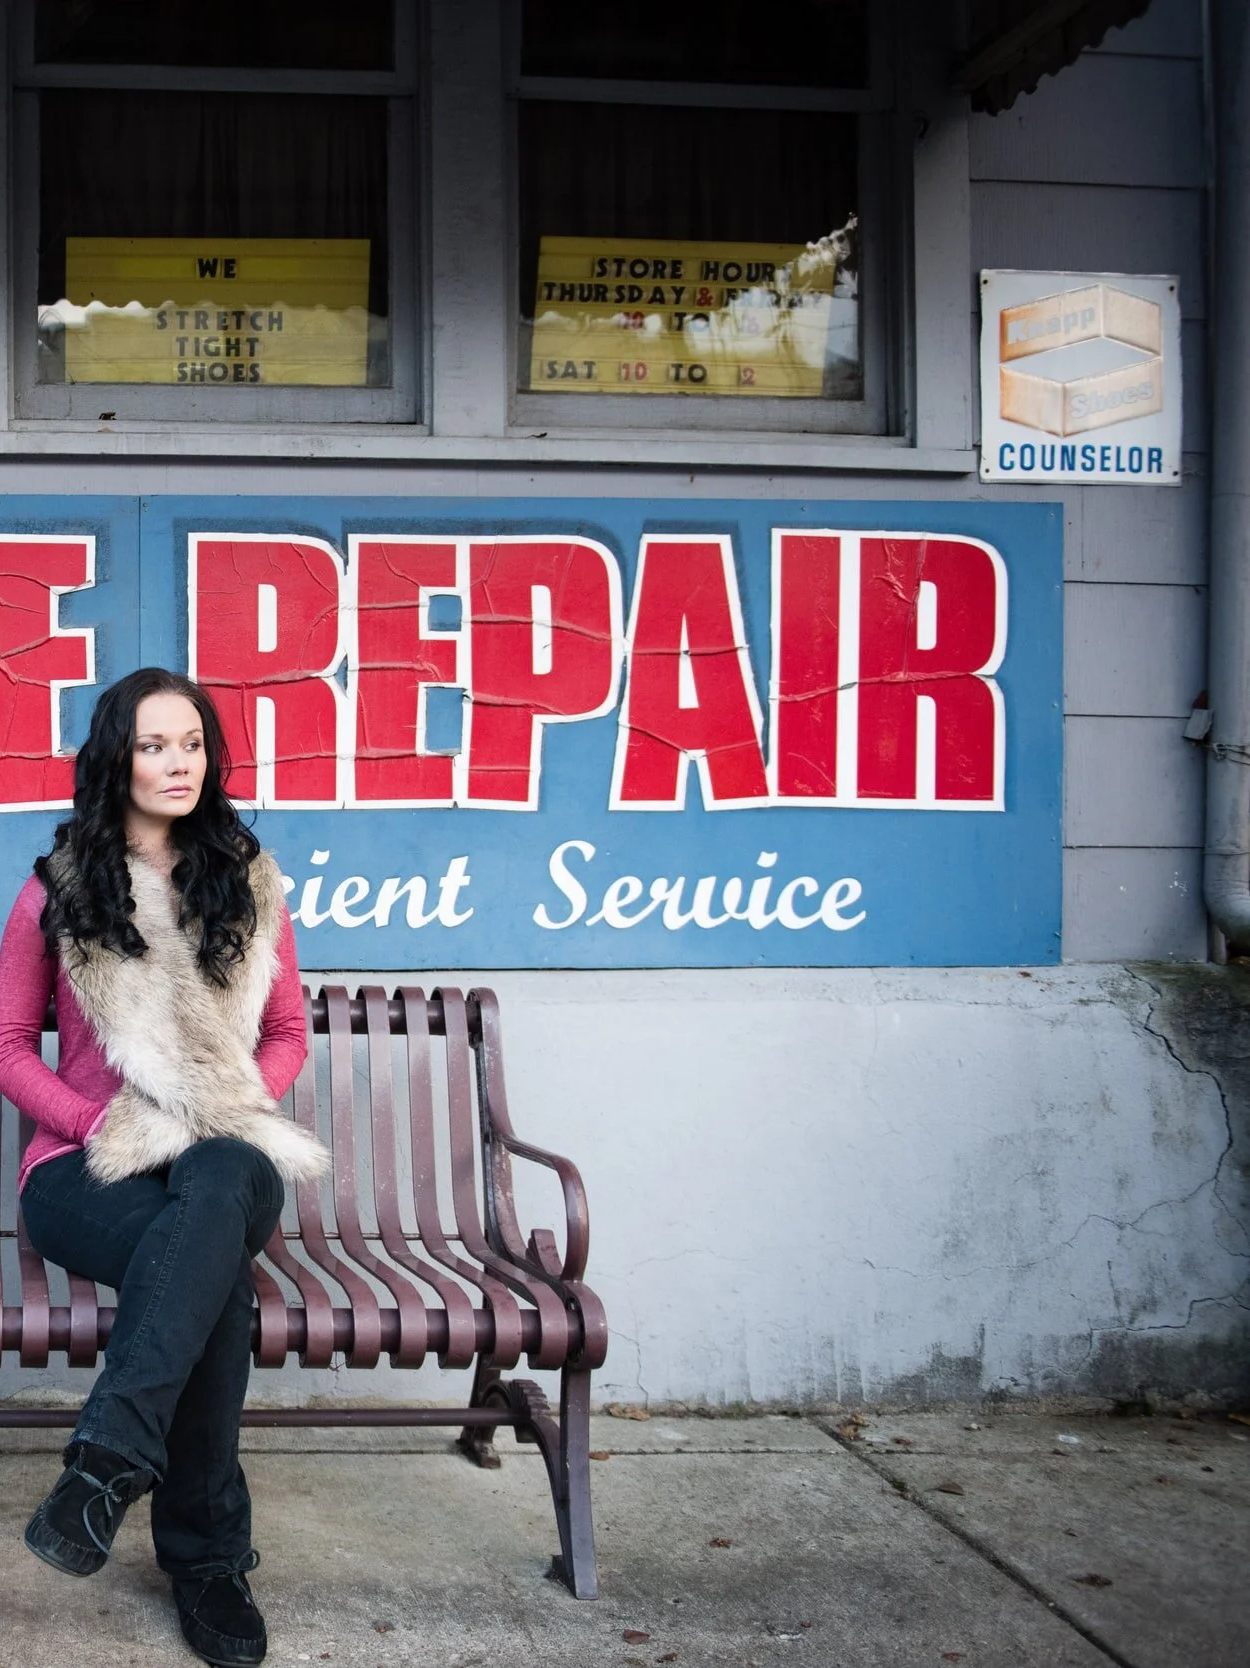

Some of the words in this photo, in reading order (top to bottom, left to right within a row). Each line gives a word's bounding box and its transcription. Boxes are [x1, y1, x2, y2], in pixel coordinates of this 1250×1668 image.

[198, 258, 236, 279] WE
[596, 257, 683, 279] STORE
[703, 261, 793, 284] HOUR
[543, 281, 686, 305] THURSDAY
[696, 287, 713, 307] &
[156, 310, 283, 331] STRETCH
[1007, 306, 1095, 344] Knapp
[176, 336, 260, 357] TIGHT
[177, 362, 261, 382] SHOES
[546, 360, 597, 380] SAT
[621, 361, 648, 381] 10
[670, 363, 708, 383] TO
[742, 367, 755, 385] 2
[1070, 382, 1155, 418] Shoes
[999, 442, 1163, 474] COUNSELOR
[187, 527, 1009, 813] REPAIR
[533, 840, 868, 932] Service
